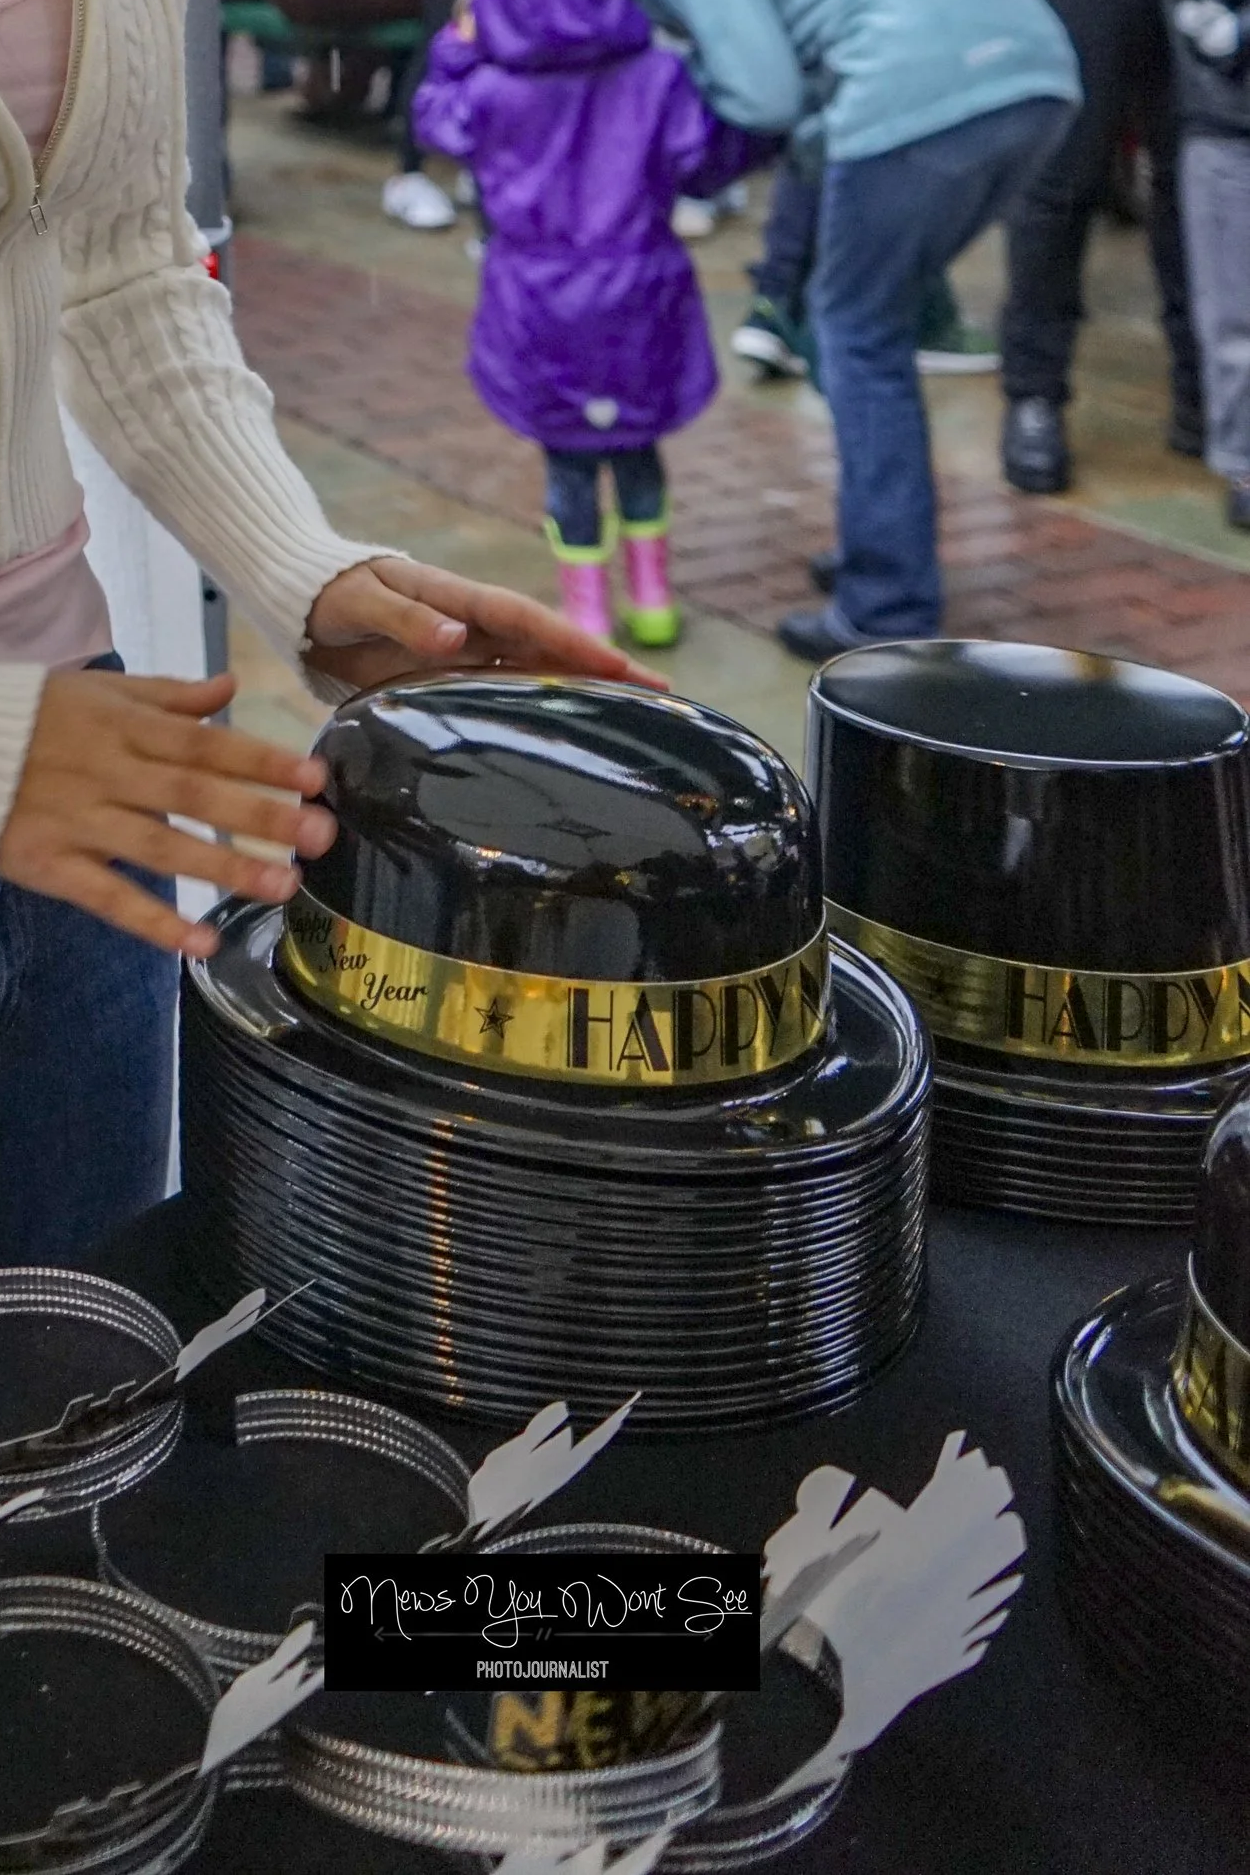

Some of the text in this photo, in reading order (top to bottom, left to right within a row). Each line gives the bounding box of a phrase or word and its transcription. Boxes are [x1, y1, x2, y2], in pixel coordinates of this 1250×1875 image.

[319, 944, 371, 973] New
[360, 972, 429, 1011] Year
[566, 968, 789, 1072] HAPPY
[1005, 965, 1226, 1054] HAPPY
